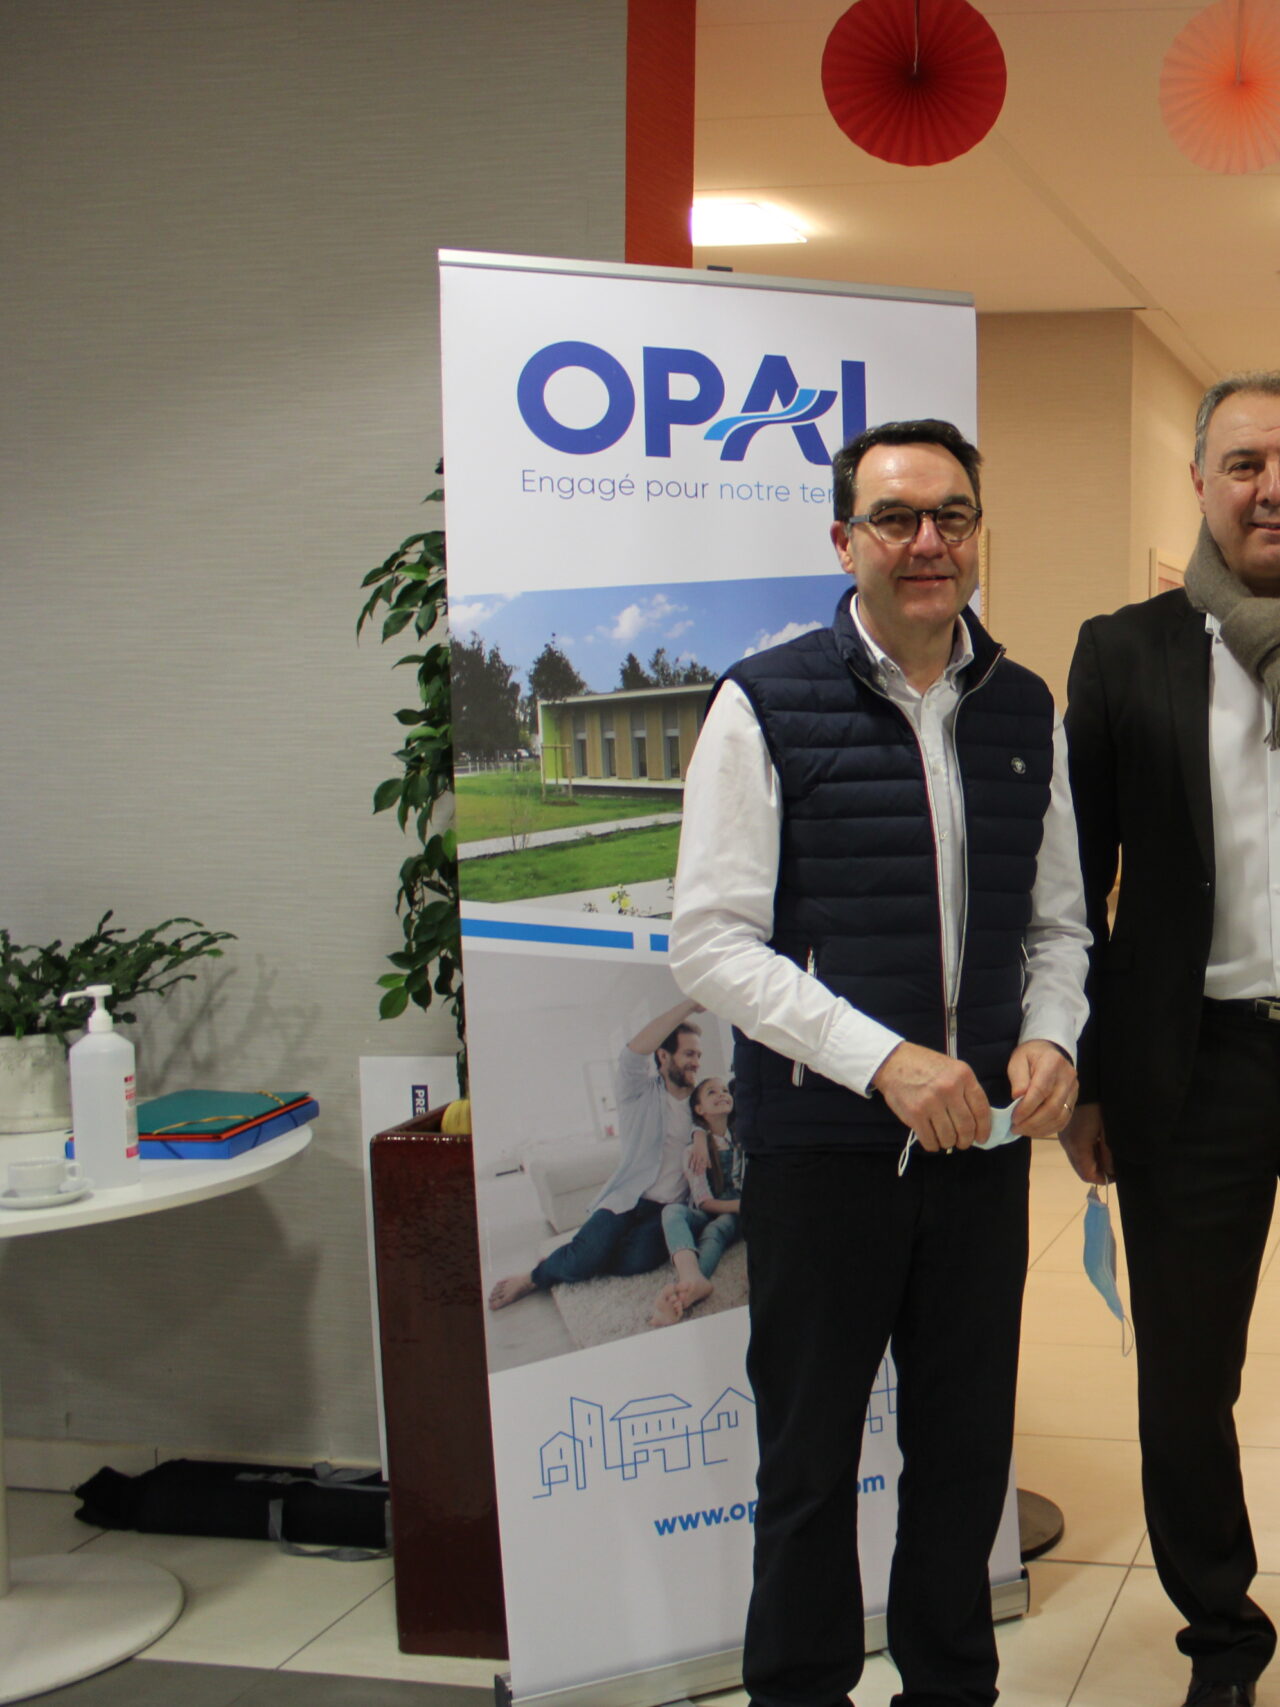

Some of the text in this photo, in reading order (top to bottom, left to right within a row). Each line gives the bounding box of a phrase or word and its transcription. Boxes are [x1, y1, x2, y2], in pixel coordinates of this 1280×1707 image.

[521, 469, 635, 501] Engagé
[646, 480, 709, 502] pour
[721, 483, 790, 503] notre
